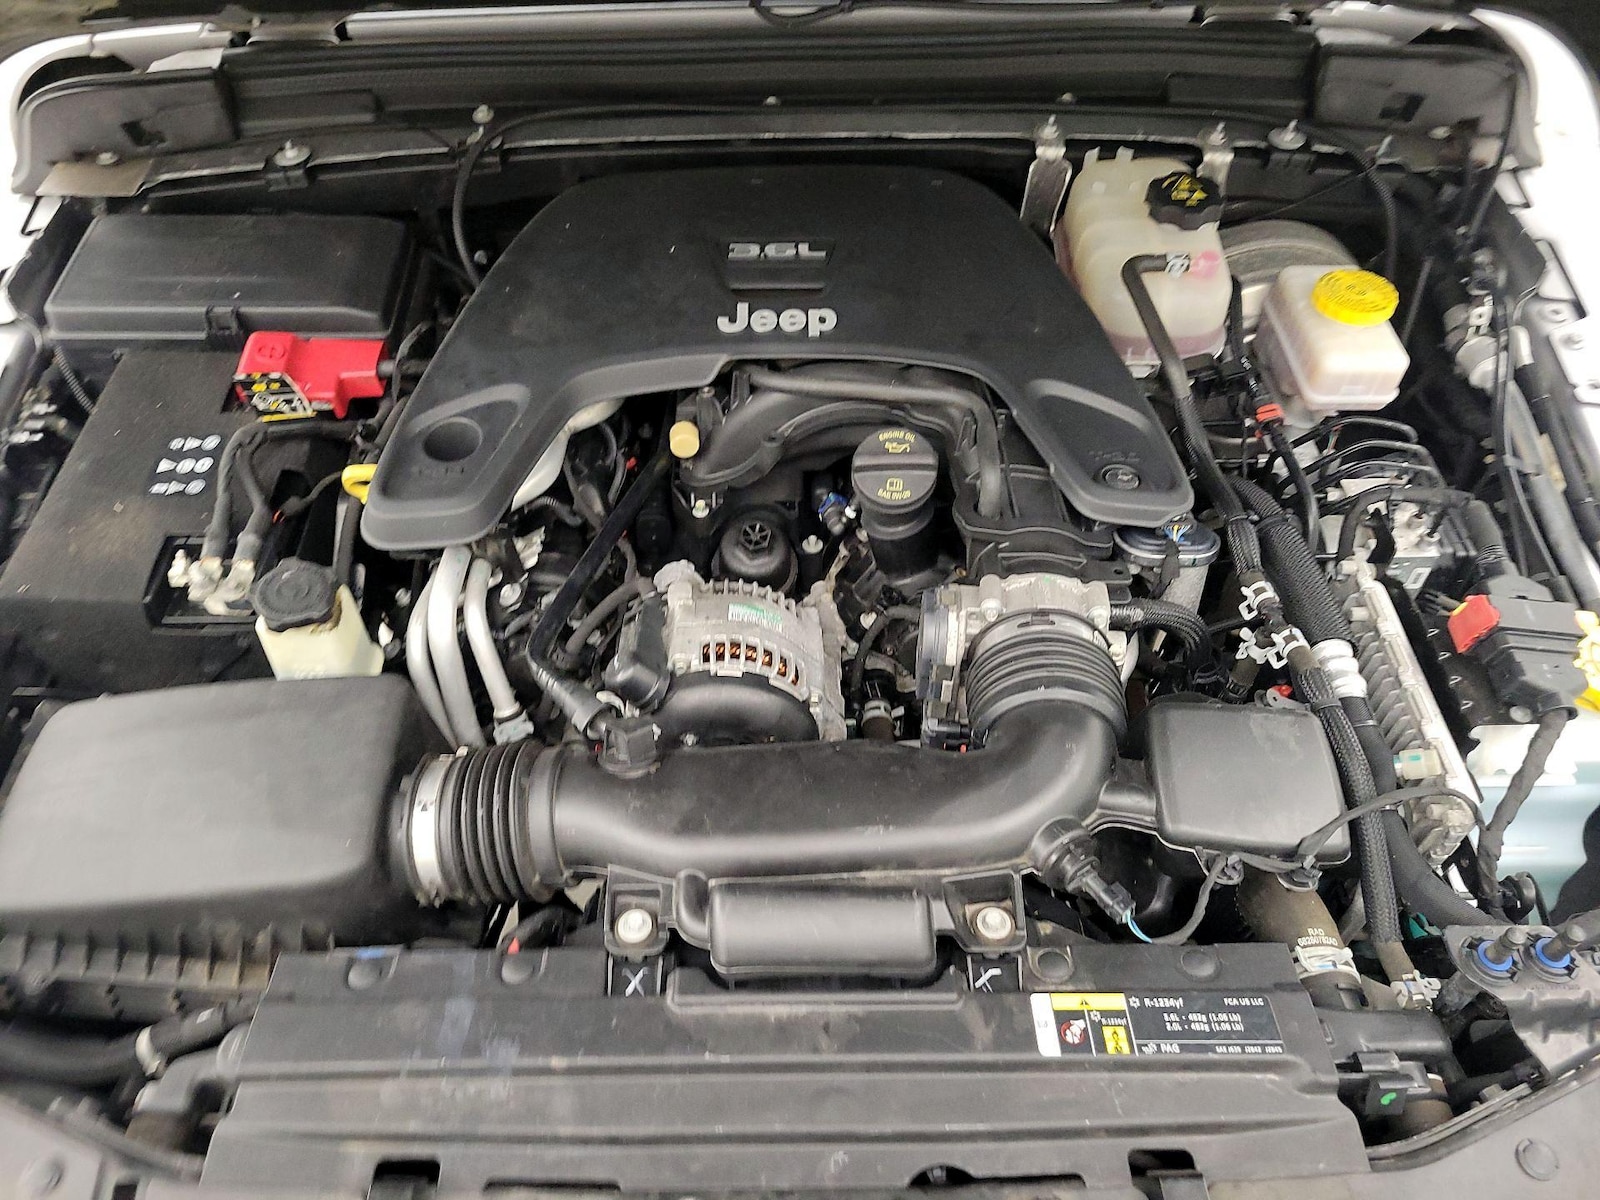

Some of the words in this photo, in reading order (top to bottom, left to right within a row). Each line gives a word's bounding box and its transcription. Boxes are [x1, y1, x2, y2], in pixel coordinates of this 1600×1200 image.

[727, 241, 827, 261] 3.6L
[716, 301, 838, 338] Jeep
[878, 430, 904, 442] ENGINE
[904, 431, 917, 443] OIL
[1307, 927, 1325, 936] RAD
[1143, 997, 1184, 1009] R-1234yf
[1223, 997, 1239, 1006] FCA
[1240, 997, 1250, 1006] US
[1250, 997, 1265, 1006] LLC
[1160, 1043, 1181, 1054] PAG
